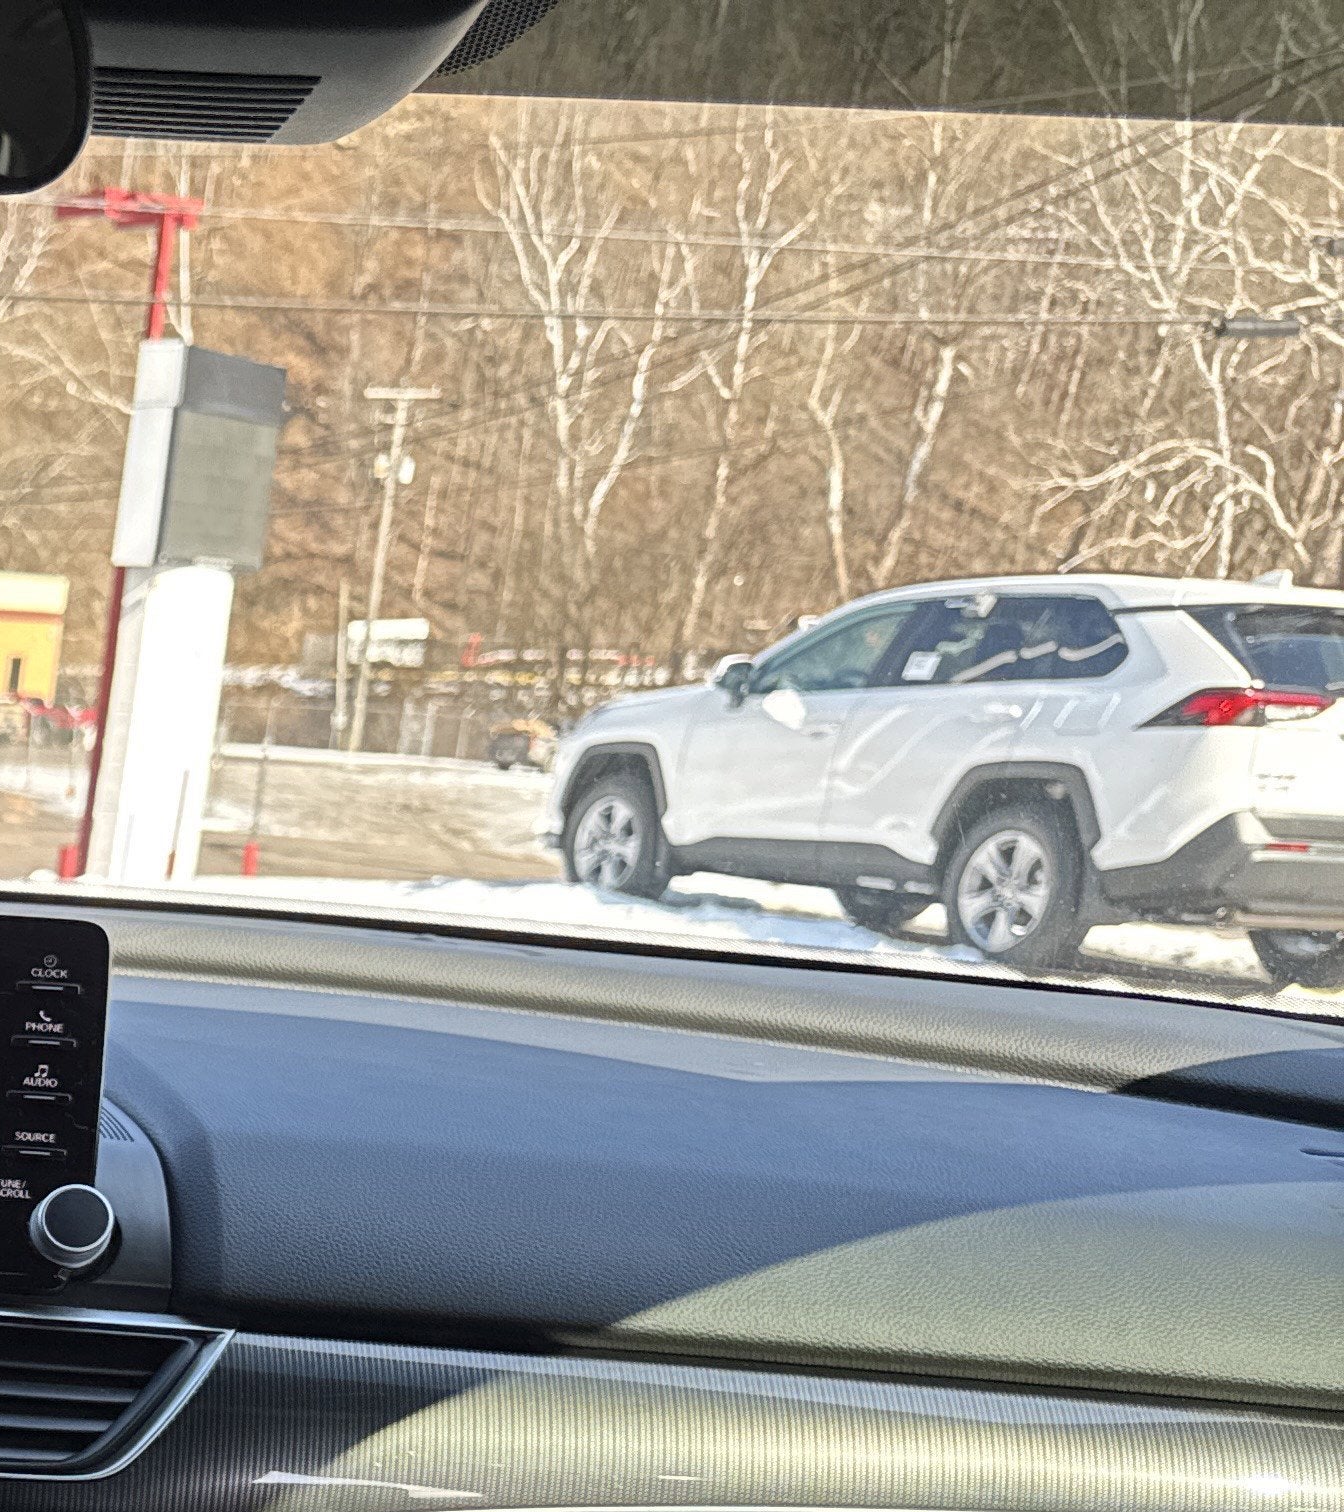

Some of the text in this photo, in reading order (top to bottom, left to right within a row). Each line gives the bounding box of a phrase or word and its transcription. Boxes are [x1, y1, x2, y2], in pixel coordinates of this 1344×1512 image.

[30, 968, 68, 979] CLOCK
[25, 1021, 64, 1034] PHONE
[23, 1077, 58, 1088] AUDIO
[14, 1131, 57, 1143] SOURCE
